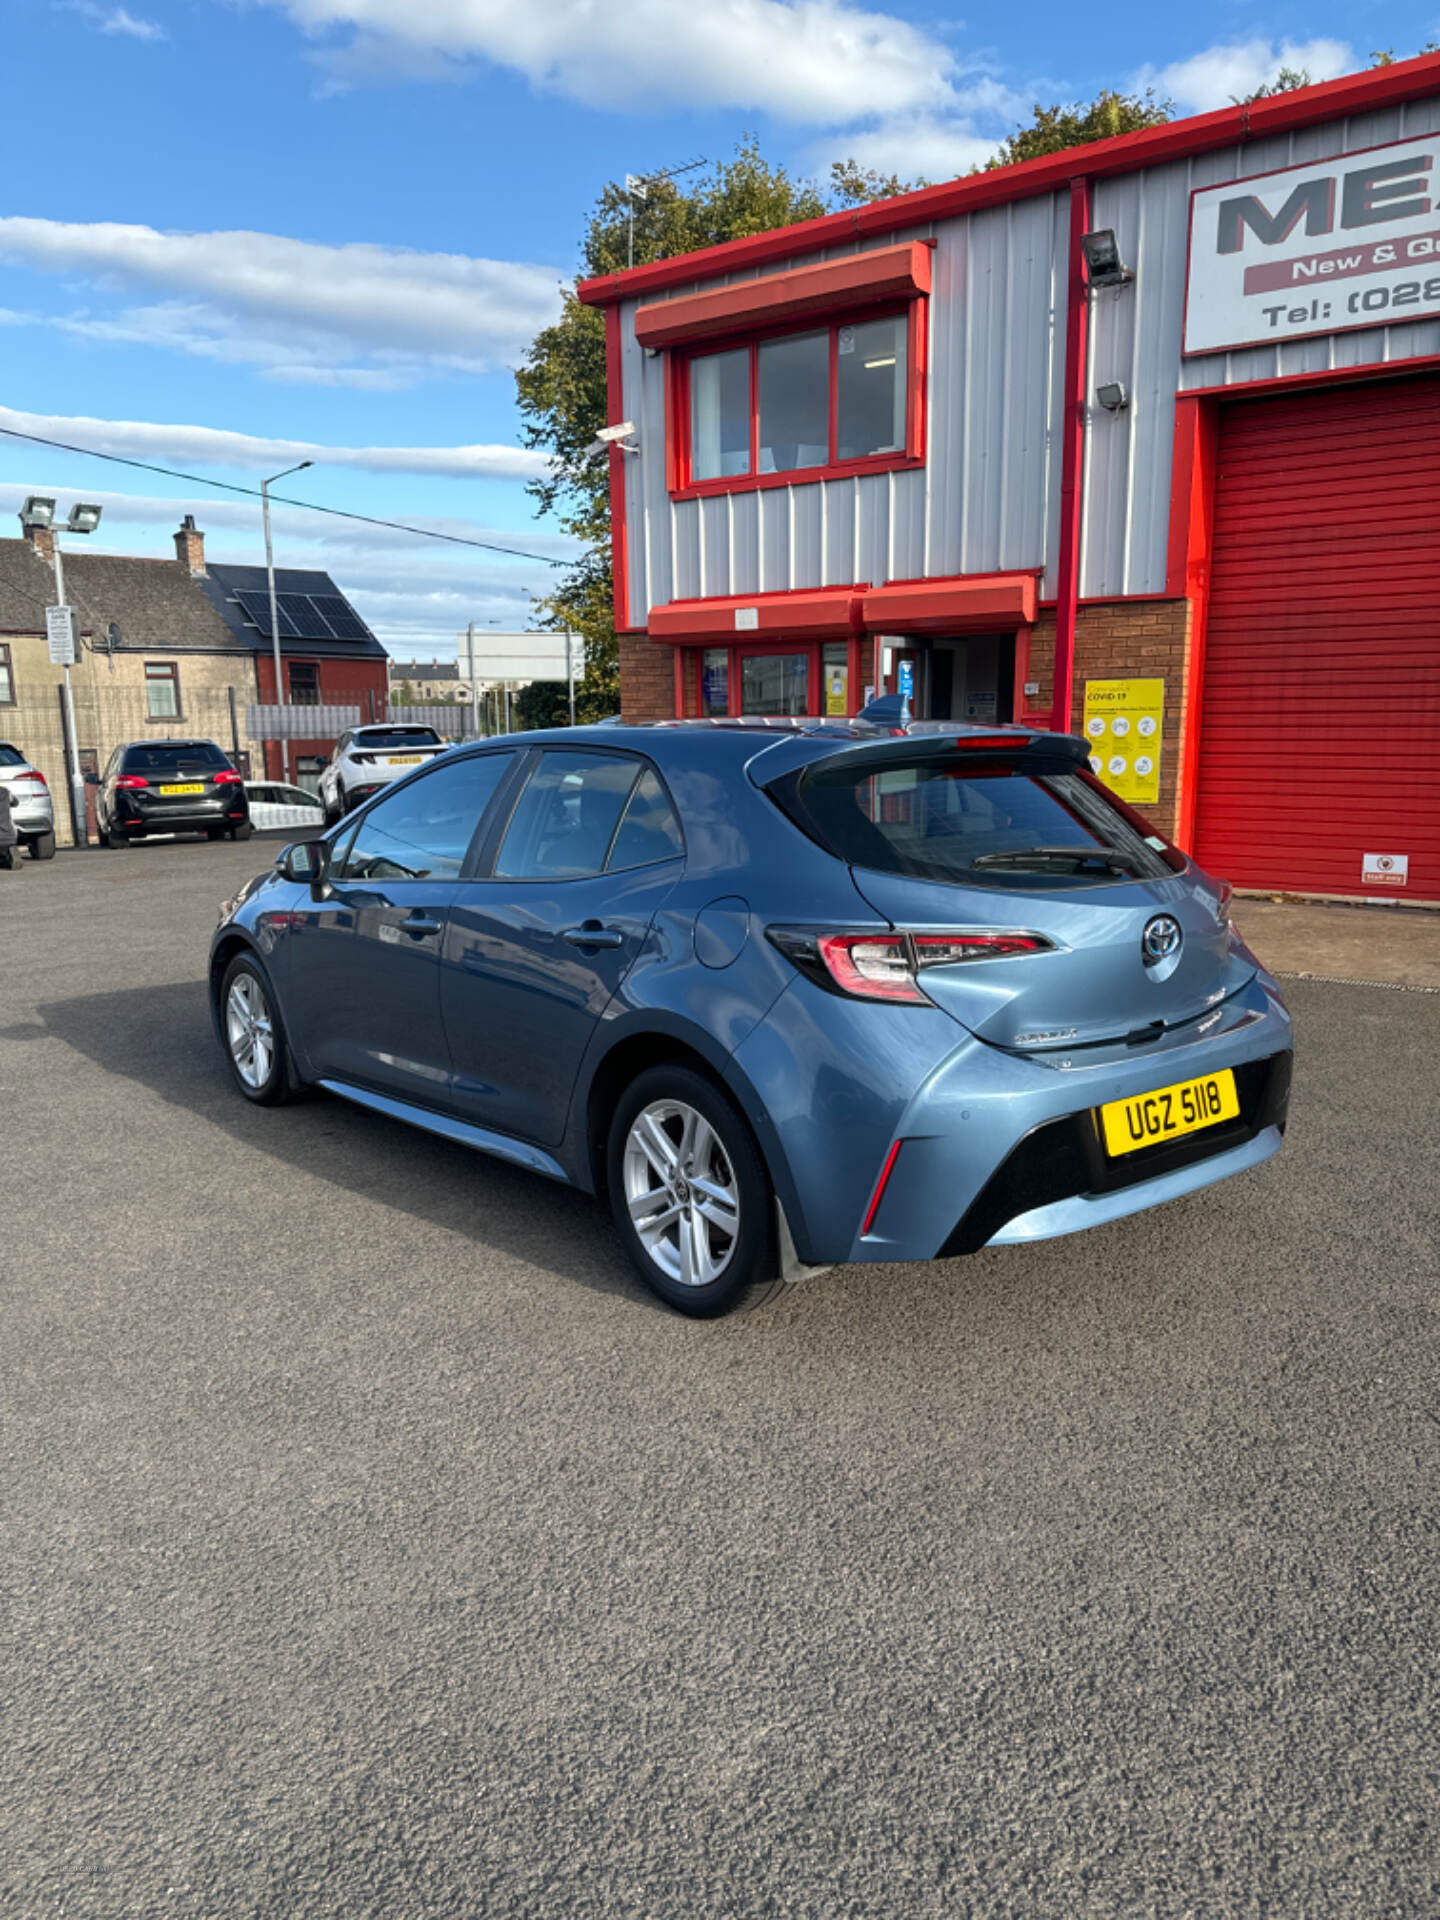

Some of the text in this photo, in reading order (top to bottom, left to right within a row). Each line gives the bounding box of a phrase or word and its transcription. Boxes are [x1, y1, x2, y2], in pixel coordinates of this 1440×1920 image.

[1217, 154, 1440, 255] ME
[1292, 237, 1440, 280] New & Q
[1262, 299, 1332, 327] Tel:
[1126, 1080, 1222, 1141] UGZ 5118
